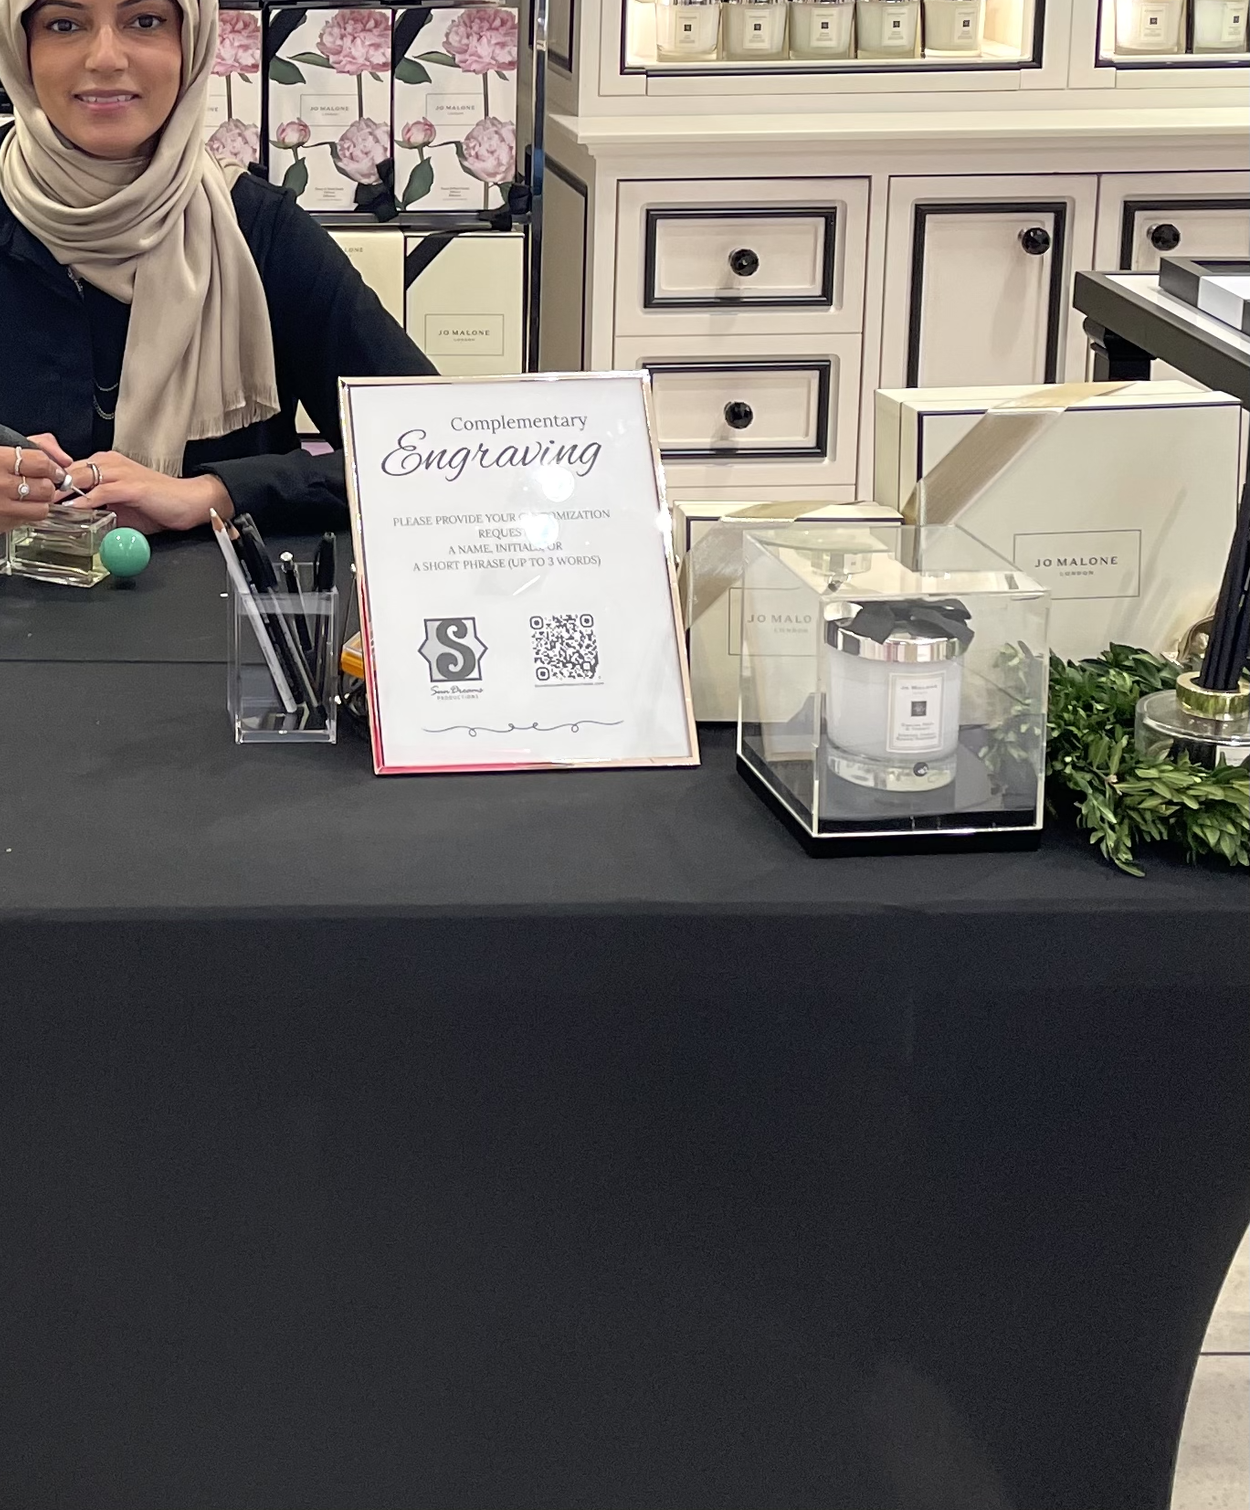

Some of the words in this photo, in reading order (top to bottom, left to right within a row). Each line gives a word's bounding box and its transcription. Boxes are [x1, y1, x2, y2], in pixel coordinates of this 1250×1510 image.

[451, 415, 588, 434] Complementary
[381, 429, 602, 482] Engraving
[393, 516, 433, 527] PLEASE
[435, 514, 482, 525] PROVIDE
[485, 512, 516, 524] YOUR
[448, 545, 456, 555] A
[458, 543, 493, 555] NAME,
[413, 562, 421, 572] A
[422, 560, 460, 571] SHORT
[463, 558, 506, 570] PHRASE
[507, 558, 527, 570] (UP
[528, 557, 545, 567] TO
[547, 556, 555, 567] 3
[556, 555, 602, 567] WORDS)
[1034, 558, 1052, 568] JO
[1056, 556, 1119, 567] MALONE
[747, 614, 766, 624] JO
